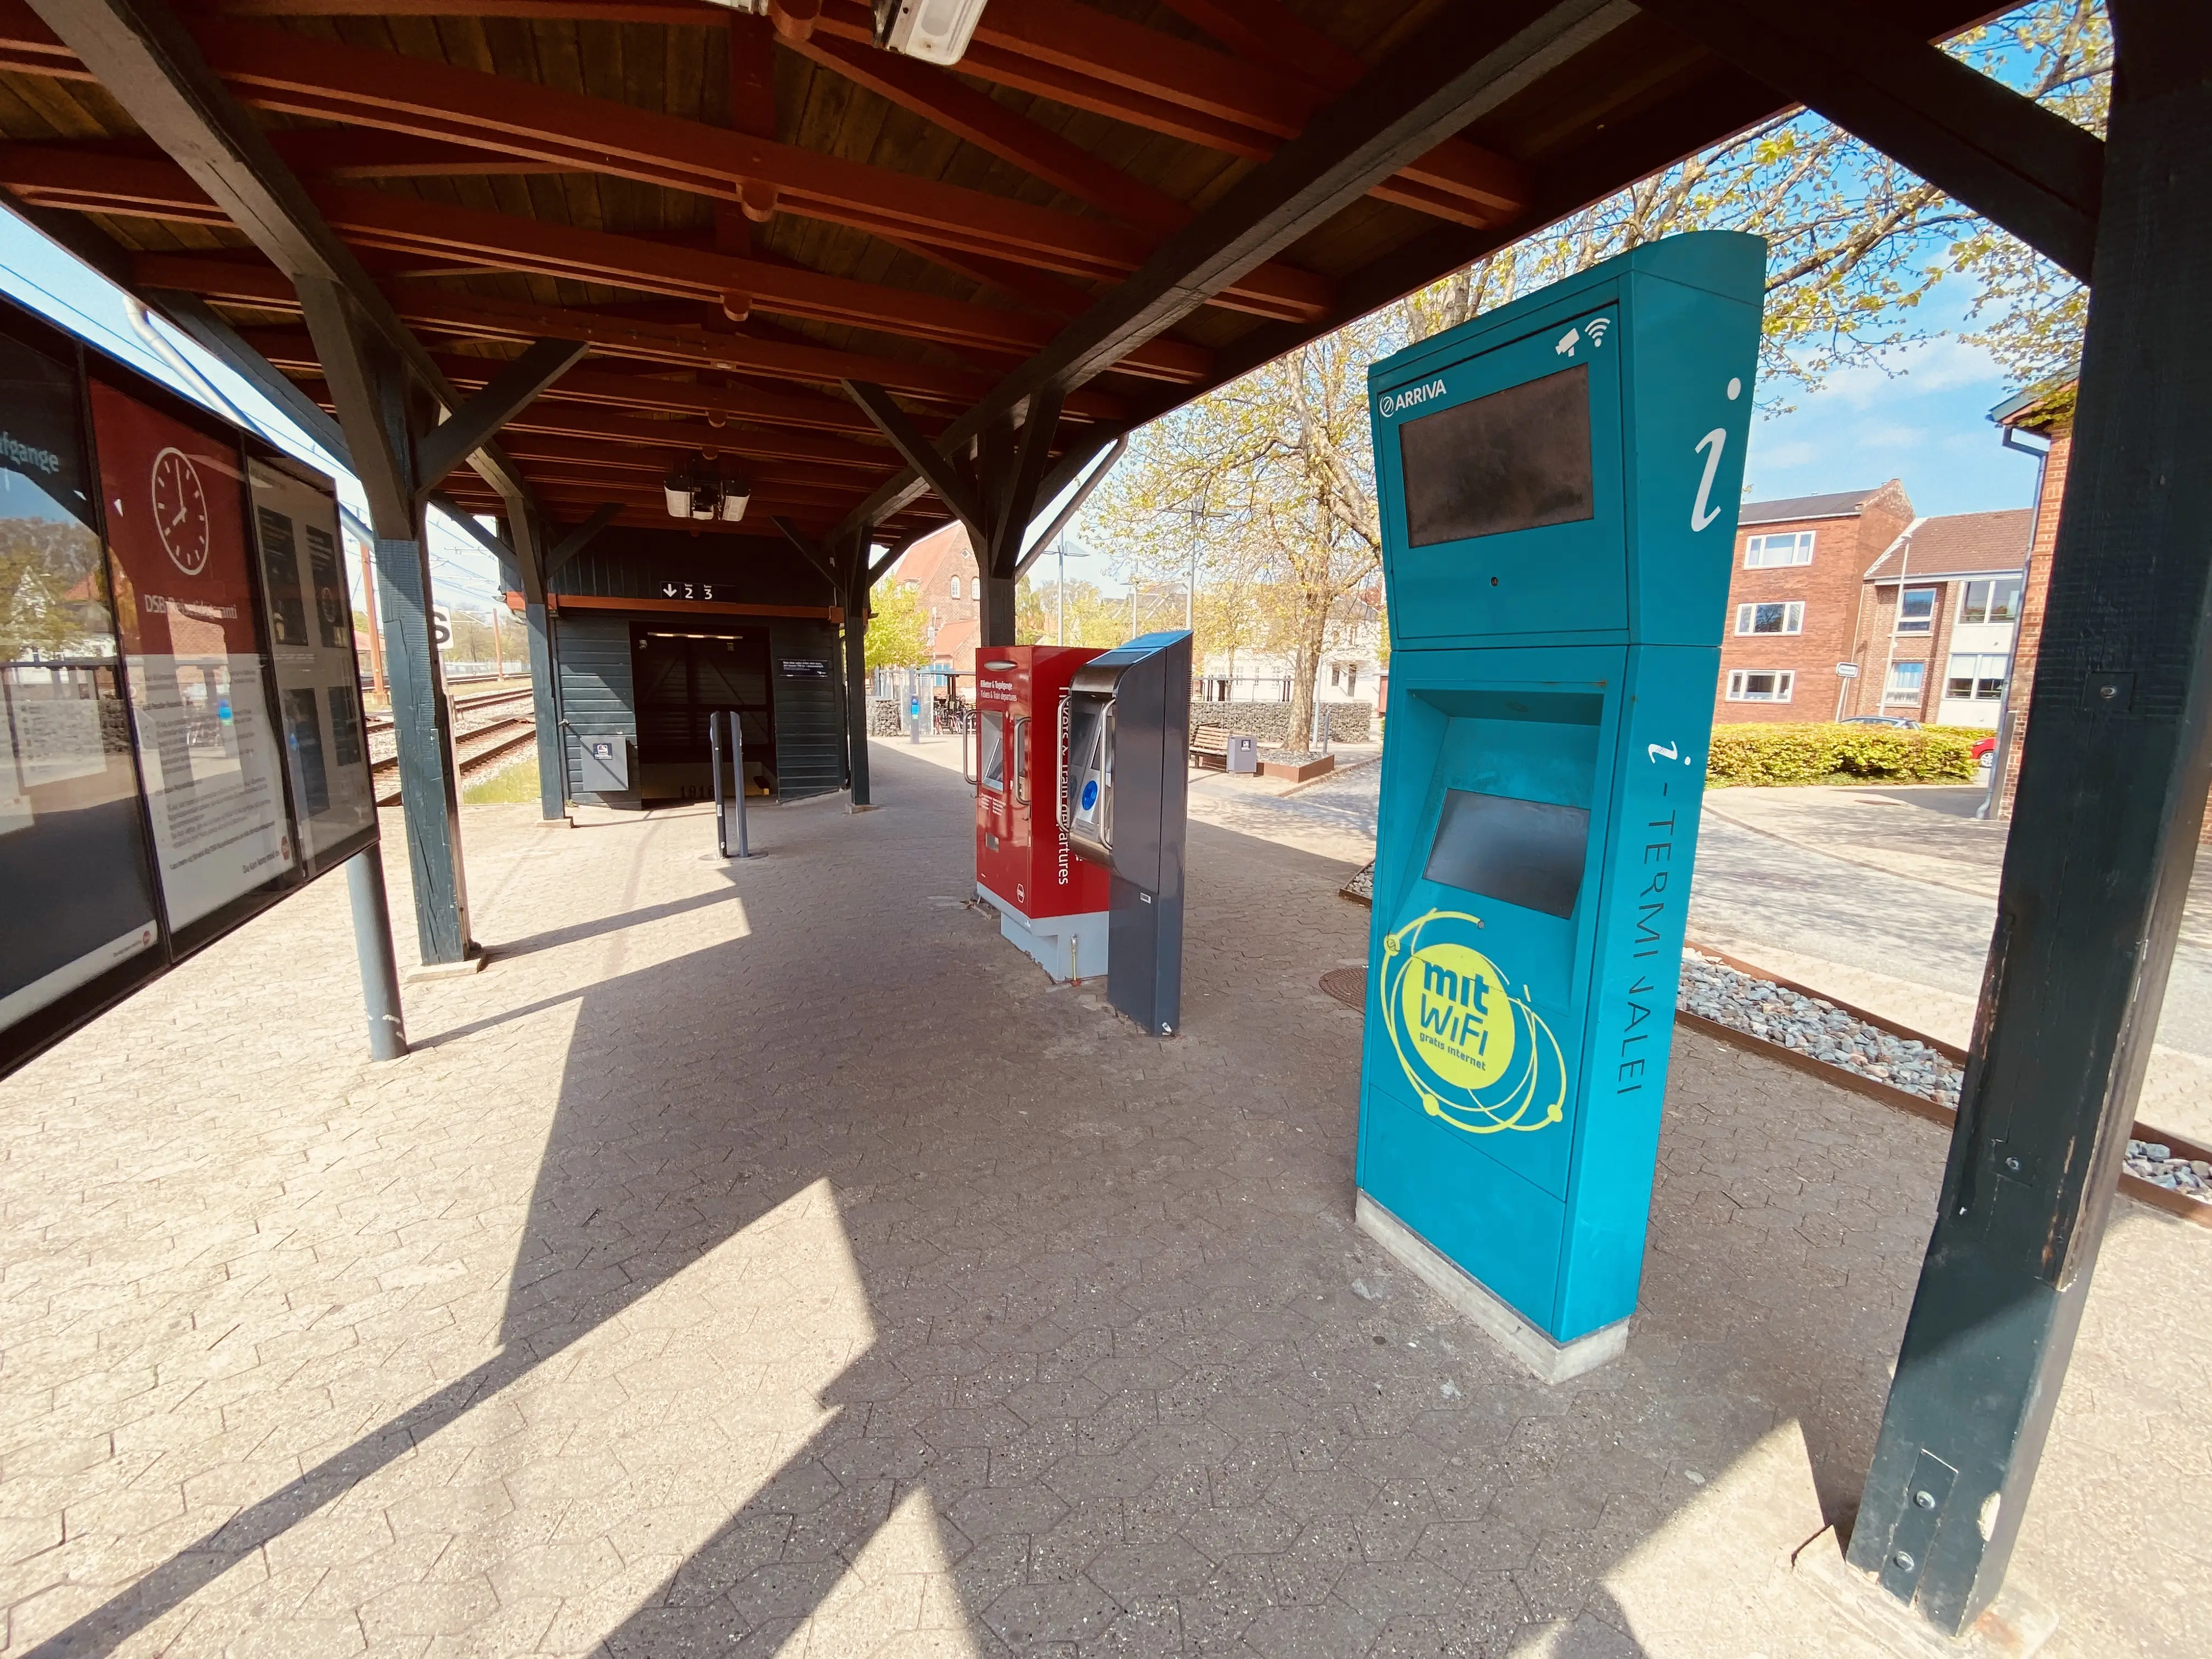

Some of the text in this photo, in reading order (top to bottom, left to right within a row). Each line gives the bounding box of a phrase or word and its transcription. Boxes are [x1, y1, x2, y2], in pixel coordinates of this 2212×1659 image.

[1395, 379, 1447, 411] ARRIVA
[0, 431, 59, 474] fgange
[1691, 377, 1741, 532] i
[145, 594, 167, 613] DSB
[685, 588, 712, 600] 2 3
[1423, 961, 1489, 1016] mit
[1420, 993, 1488, 1056] WiFi
[1420, 1032, 1486, 1071] gratis internet
